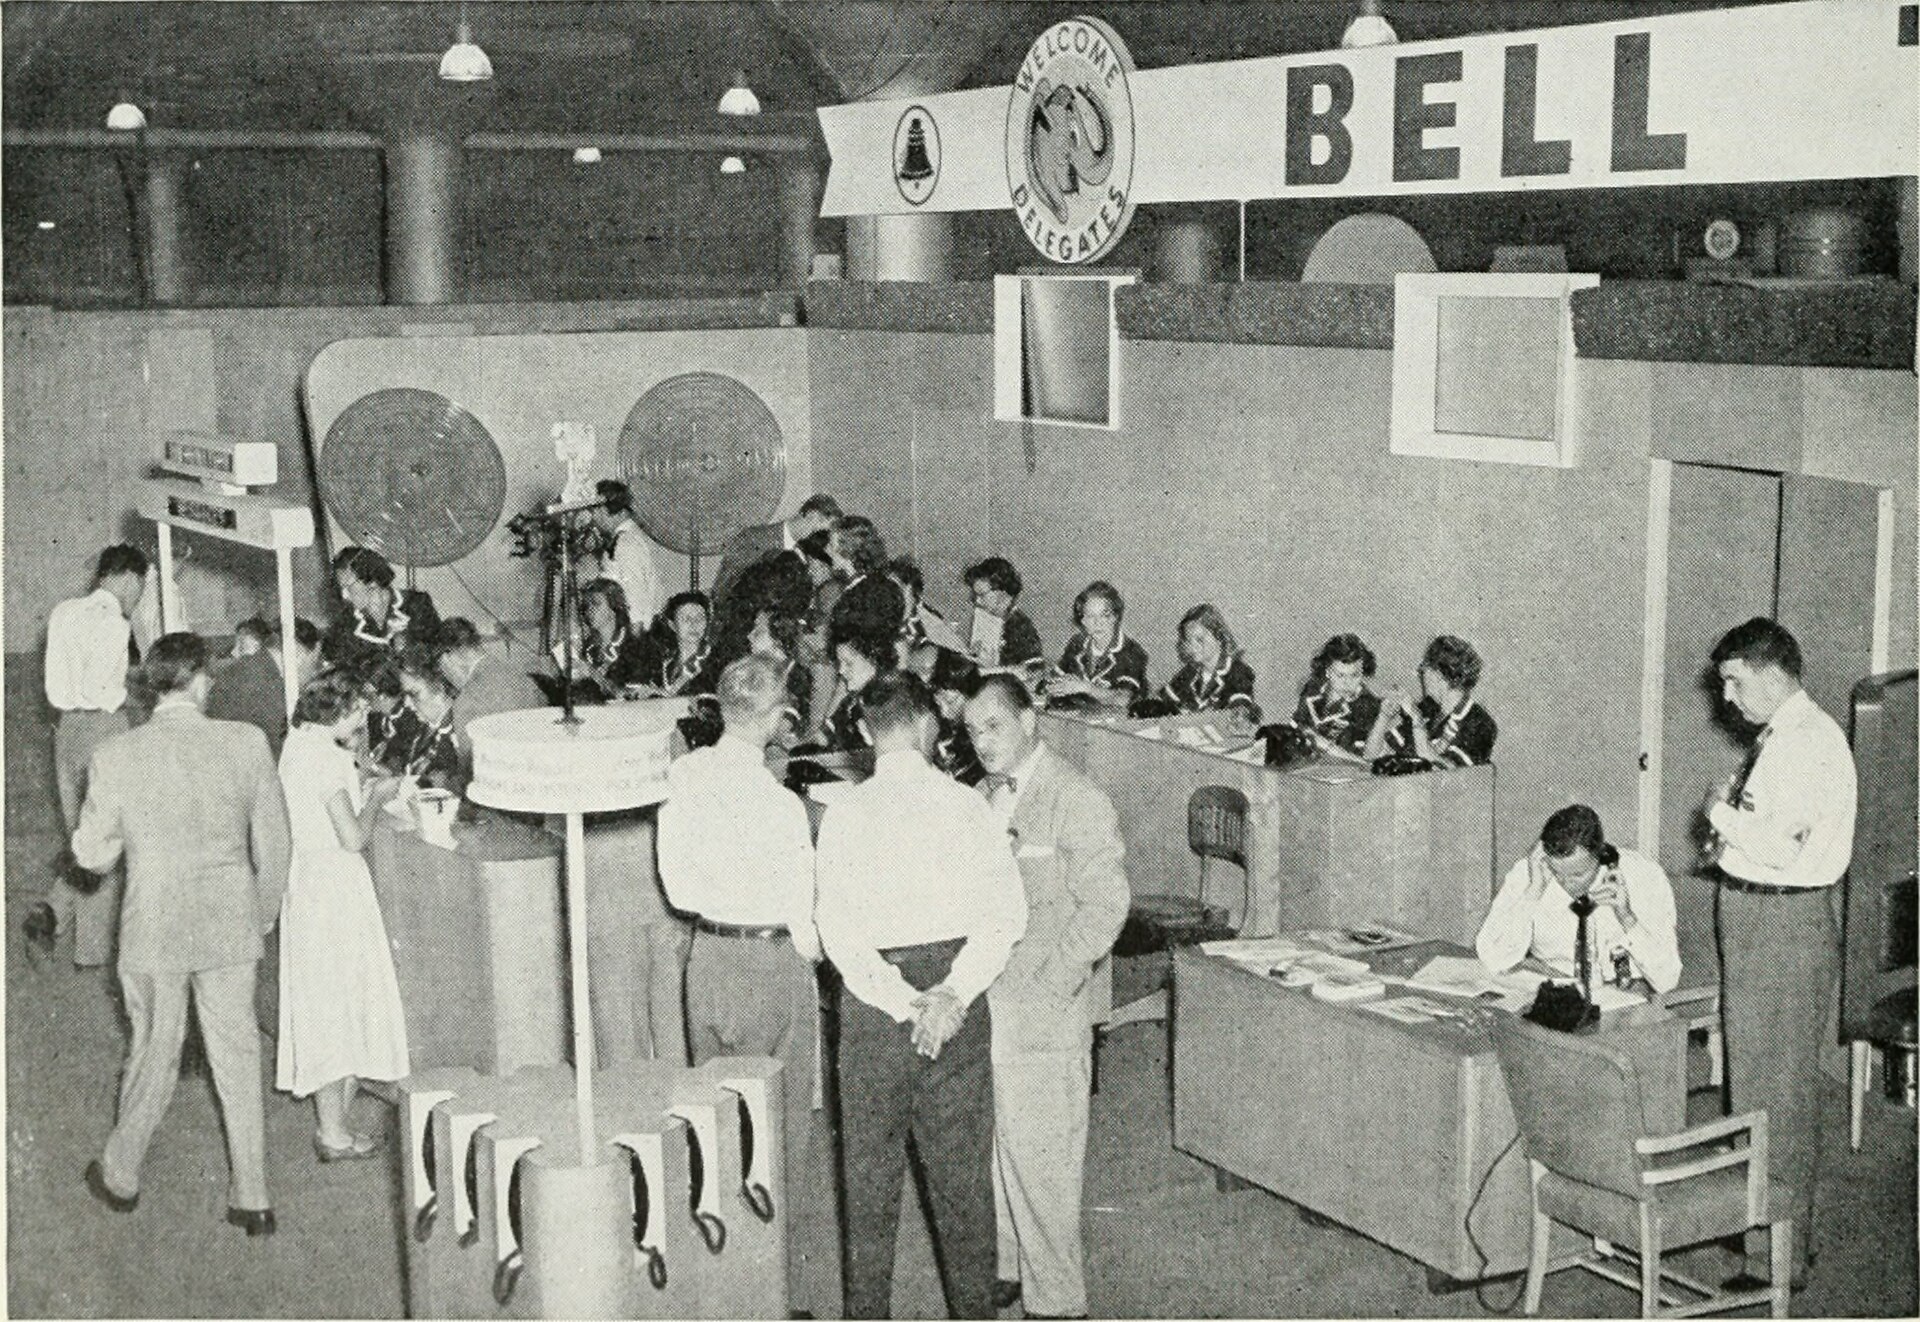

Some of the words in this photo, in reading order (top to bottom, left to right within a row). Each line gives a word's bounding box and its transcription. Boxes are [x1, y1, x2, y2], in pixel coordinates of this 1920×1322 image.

[1017, 24, 1120, 94] WELCOME
[1284, 31, 1688, 187] BELL
[1013, 182, 1126, 262] DELEGATES
